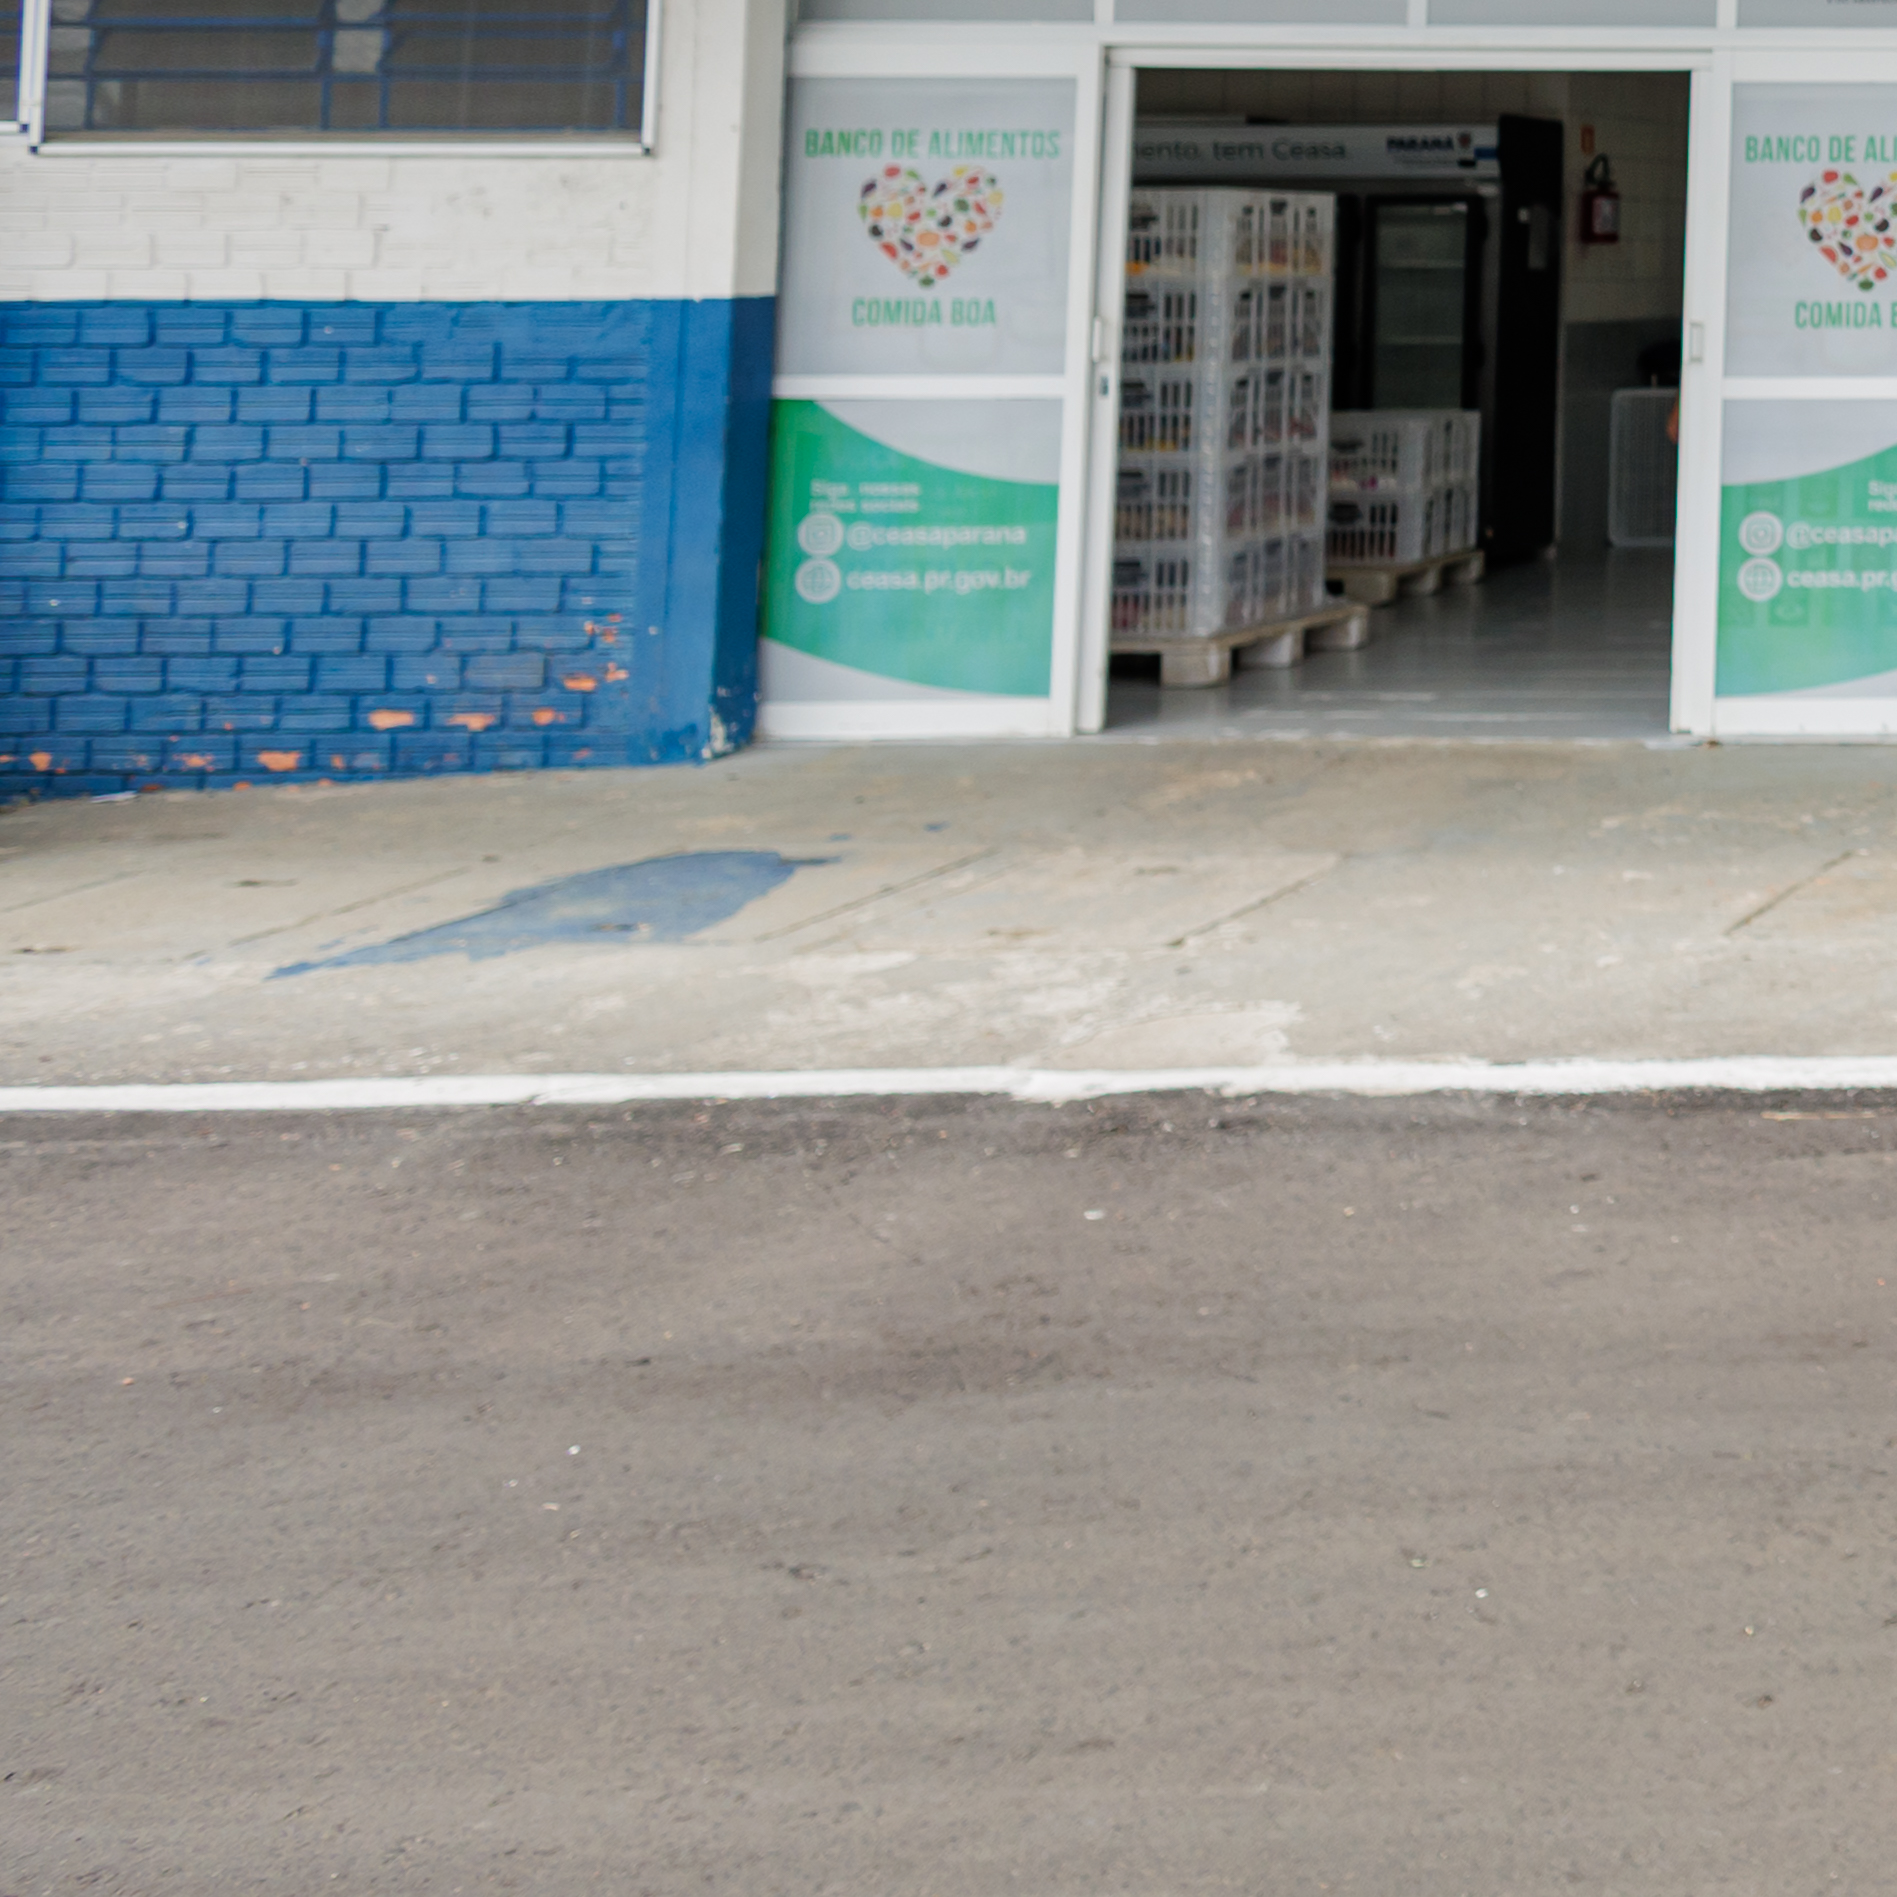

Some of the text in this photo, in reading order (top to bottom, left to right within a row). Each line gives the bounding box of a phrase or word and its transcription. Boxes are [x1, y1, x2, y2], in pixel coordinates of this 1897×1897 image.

[804, 128, 1061, 160] BANCO DE ALIMENTOS
[1212, 140, 1264, 161] tem
[1745, 135, 1821, 163] BANCO
[1828, 135, 1857, 163] DE
[851, 297, 996, 327] COMIDA BOA
[1794, 300, 1882, 328] COMIDA
[846, 521, 1027, 550] @ceasaparana
[846, 565, 1032, 595] ceasa.pr.gov.br
